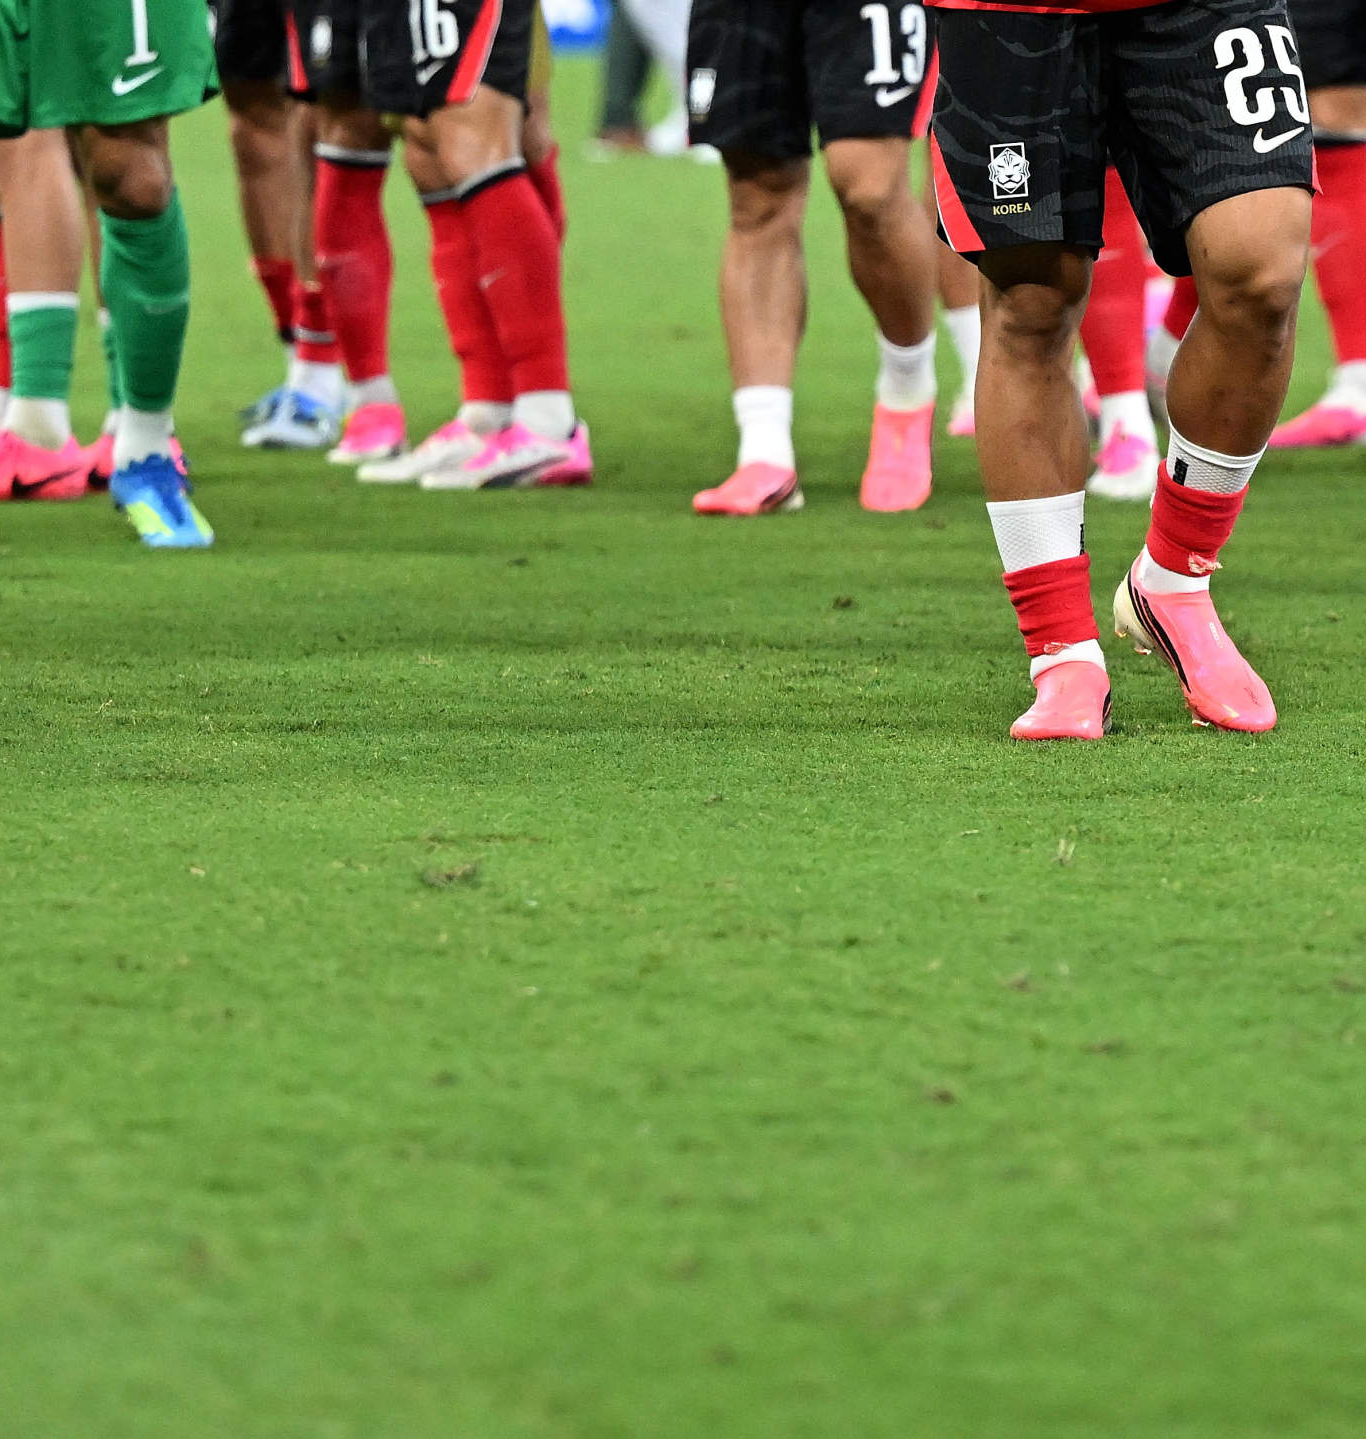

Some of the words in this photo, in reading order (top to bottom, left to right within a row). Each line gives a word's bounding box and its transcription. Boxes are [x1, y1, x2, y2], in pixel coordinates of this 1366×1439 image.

[860, 2, 928, 86] 13
[1213, 24, 1309, 126] 25
[992, 202, 1032, 216] KOREA
